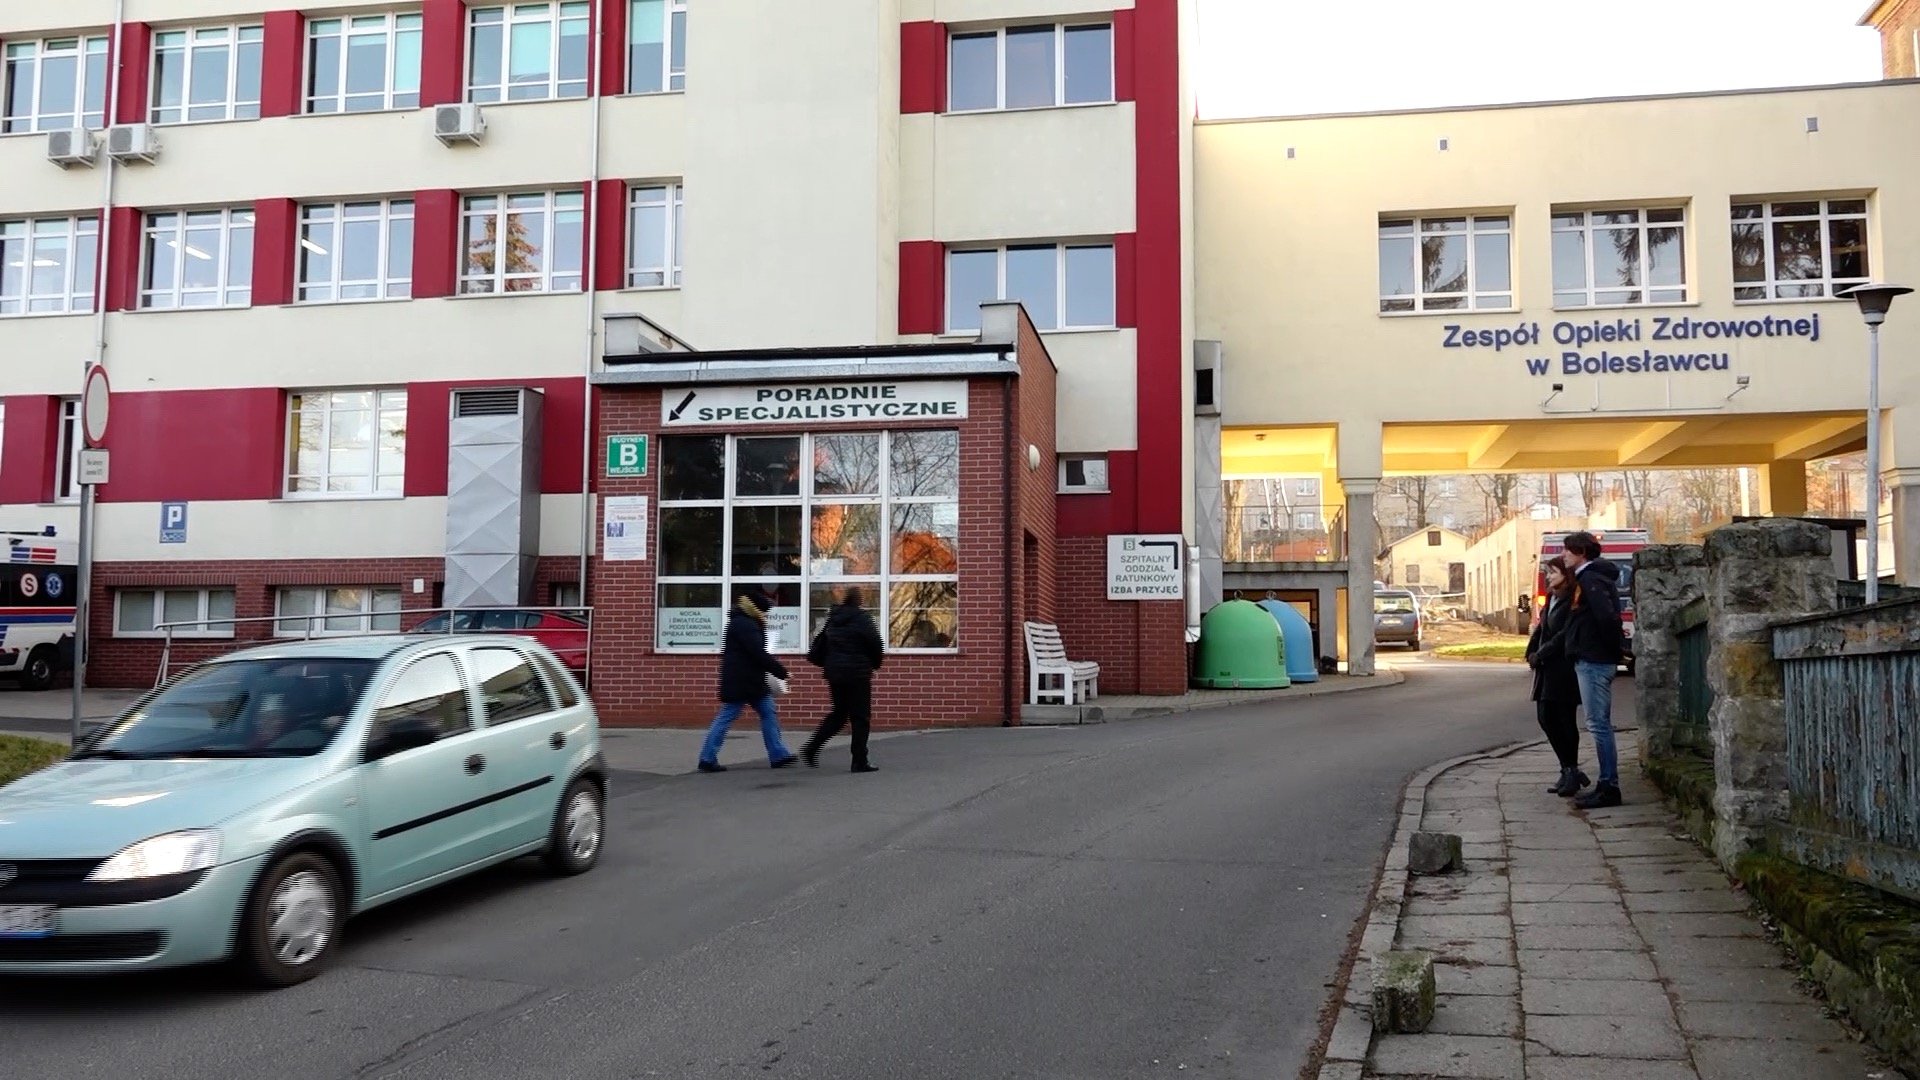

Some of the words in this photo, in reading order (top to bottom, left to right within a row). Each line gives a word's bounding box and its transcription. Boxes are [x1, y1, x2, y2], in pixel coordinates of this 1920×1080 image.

[1443, 323, 1539, 351] Zespół
[1552, 319, 1640, 348] Opieki
[1652, 313, 1820, 342] Zdrowotnej
[1525, 356, 1551, 376] w
[1562, 351, 1730, 375] Bolesławcu
[757, 385, 897, 402] PORADNIE
[698, 401, 958, 421] SPECJALISTYCZNE
[620, 444, 638, 465] B
[167, 506, 182, 528] P
[1120, 555, 1171, 563] SZPITALNY
[1125, 565, 1166, 573] ODDZIAŁ
[24, 577, 34, 593] S
[1115, 574, 1176, 582] RATUNKOWY
[1111, 586, 1132, 594] IZBA
[1135, 585, 1179, 594] PRZYJĘĆ
